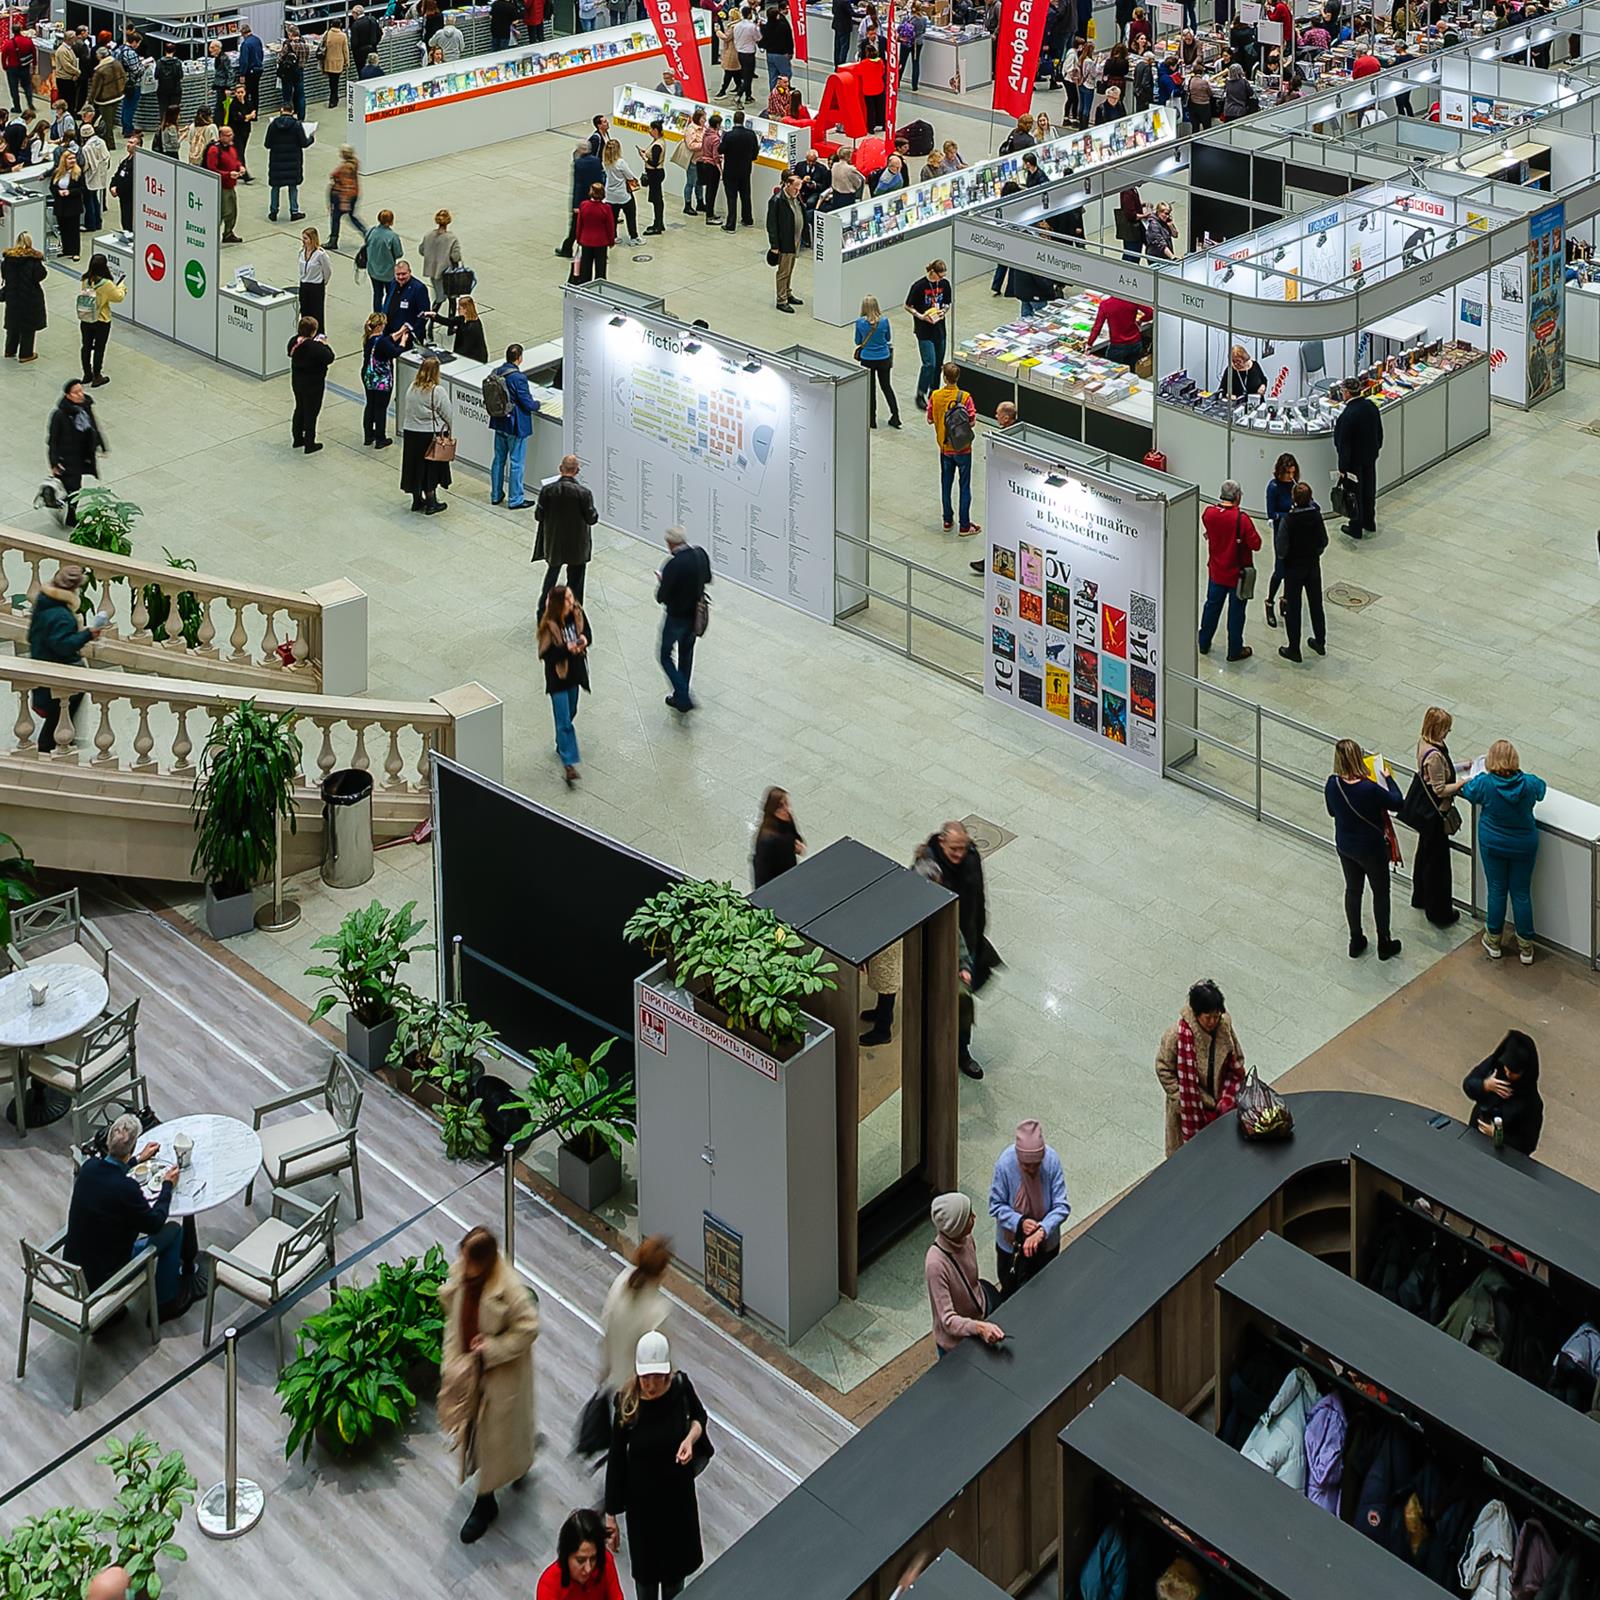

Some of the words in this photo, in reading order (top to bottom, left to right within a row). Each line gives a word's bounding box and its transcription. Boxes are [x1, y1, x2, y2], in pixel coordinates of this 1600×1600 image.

[1007, 27, 1031, 93] Альфа
[145, 175, 166, 197] 18+
[188, 191, 204, 212] 6+
[816, 215, 826, 263] ТОП-ЛИСТ
[970, 233, 1004, 252] ABCdesign
[1037, 252, 1046, 263] Ad
[1047, 253, 1082, 273] Marginem
[1181, 293, 1205, 309] ТЕКСТ
[234, 305, 248, 319] ВХОД
[228, 315, 254, 333] ENTRANCE
[1047, 511, 1109, 545] Букмейте
[644, 991, 662, 1008] ПРИ
[663, 1002, 699, 1028] ПОЖАРЕ
[699, 1023, 740, 1053] ЗВОНИТЬ
[760, 1058, 774, 1073] 112
